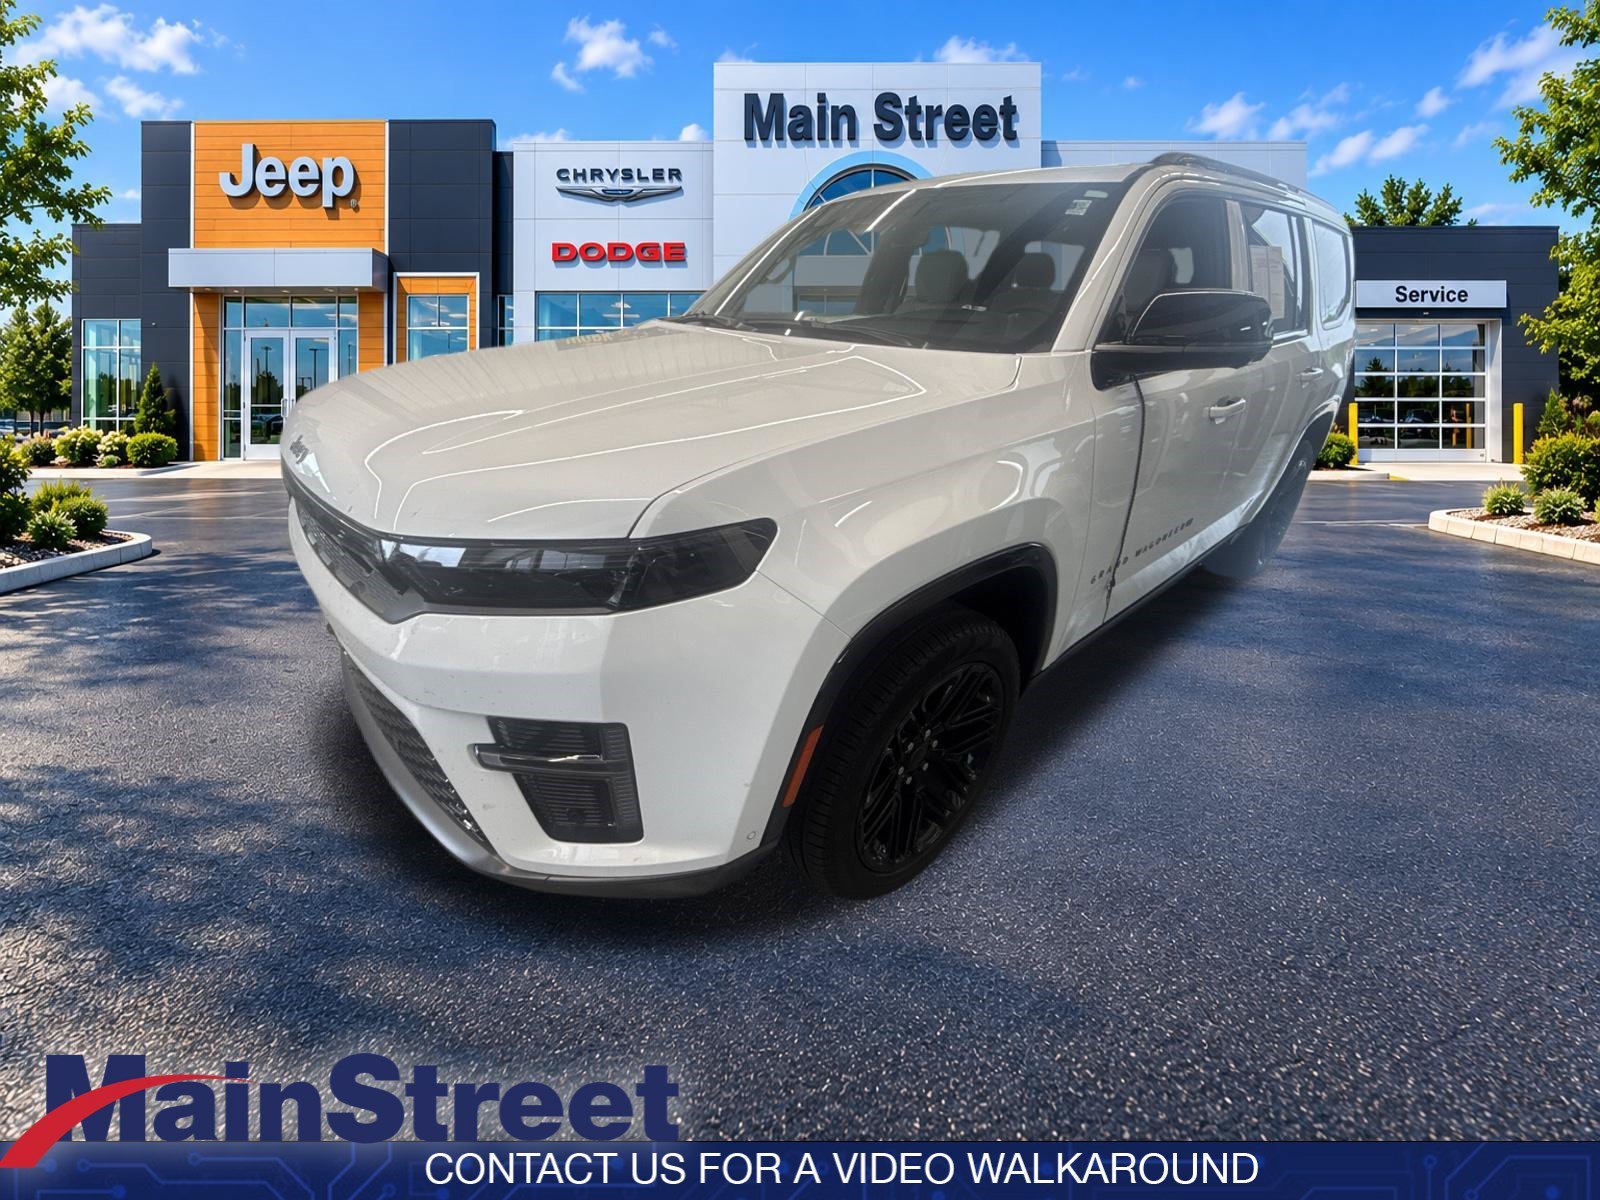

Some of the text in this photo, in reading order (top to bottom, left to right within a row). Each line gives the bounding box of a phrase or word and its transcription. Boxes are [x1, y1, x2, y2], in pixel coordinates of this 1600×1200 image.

[744, 91, 1018, 141] Main Street
[219, 143, 355, 207] Jeep
[556, 168, 683, 181] CHRYSLER
[552, 242, 686, 262] DODGE
[1395, 285, 1469, 302] Service
